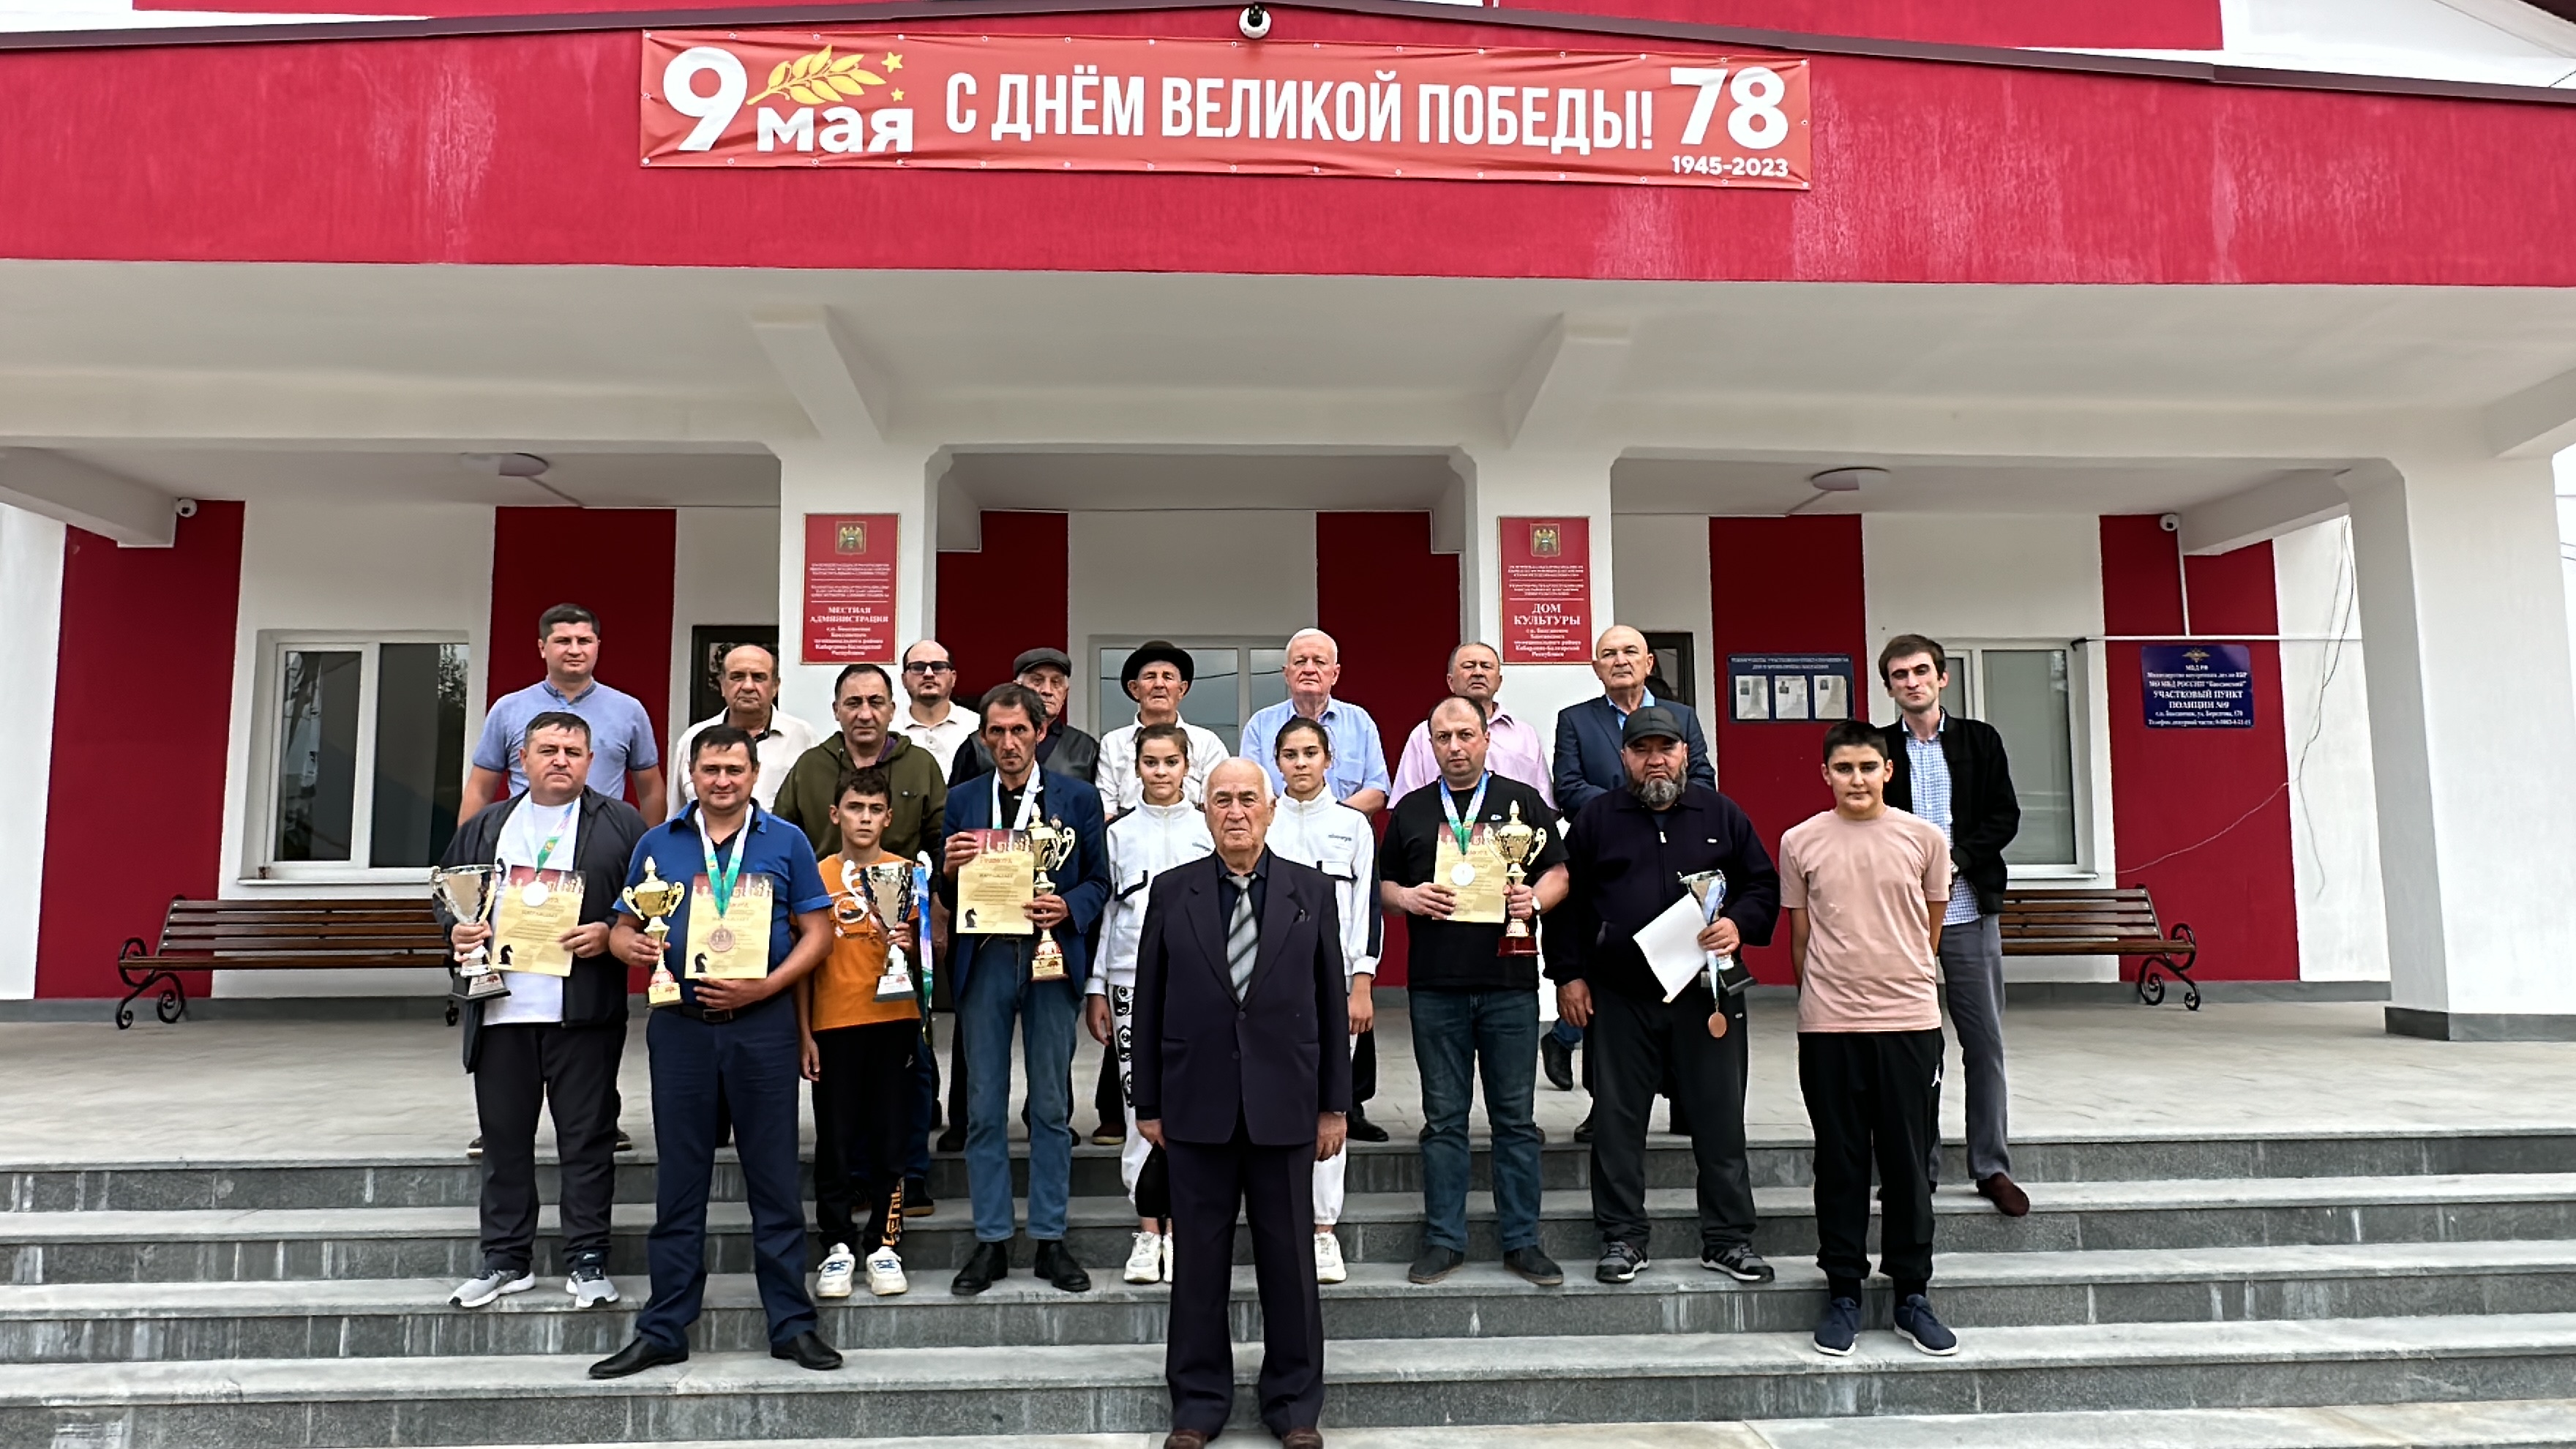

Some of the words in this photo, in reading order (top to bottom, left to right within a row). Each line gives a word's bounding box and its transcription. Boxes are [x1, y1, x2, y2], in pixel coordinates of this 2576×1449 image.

[663, 46, 749, 151] 9
[756, 107, 914, 154] мая
[1669, 66, 1789, 150] 78
[946, 72, 978, 135] С
[990, 65, 1144, 142] ДНЁМ
[1162, 70, 1402, 143] ВЕЛИКОЙ
[1418, 83, 1653, 155] ПОБЕДЫ!
[1671, 155, 1789, 177] 1945-2023
[1532, 603, 1562, 614] ДОМ
[1513, 615, 1581, 626] КУЛЬТУРЫ
[2153, 689, 2212, 698] УЧАСТКОВЫЙ
[2214, 690, 2243, 698] ПУНКТ
[2168, 701, 2214, 709] ПОЛИЦИИ
